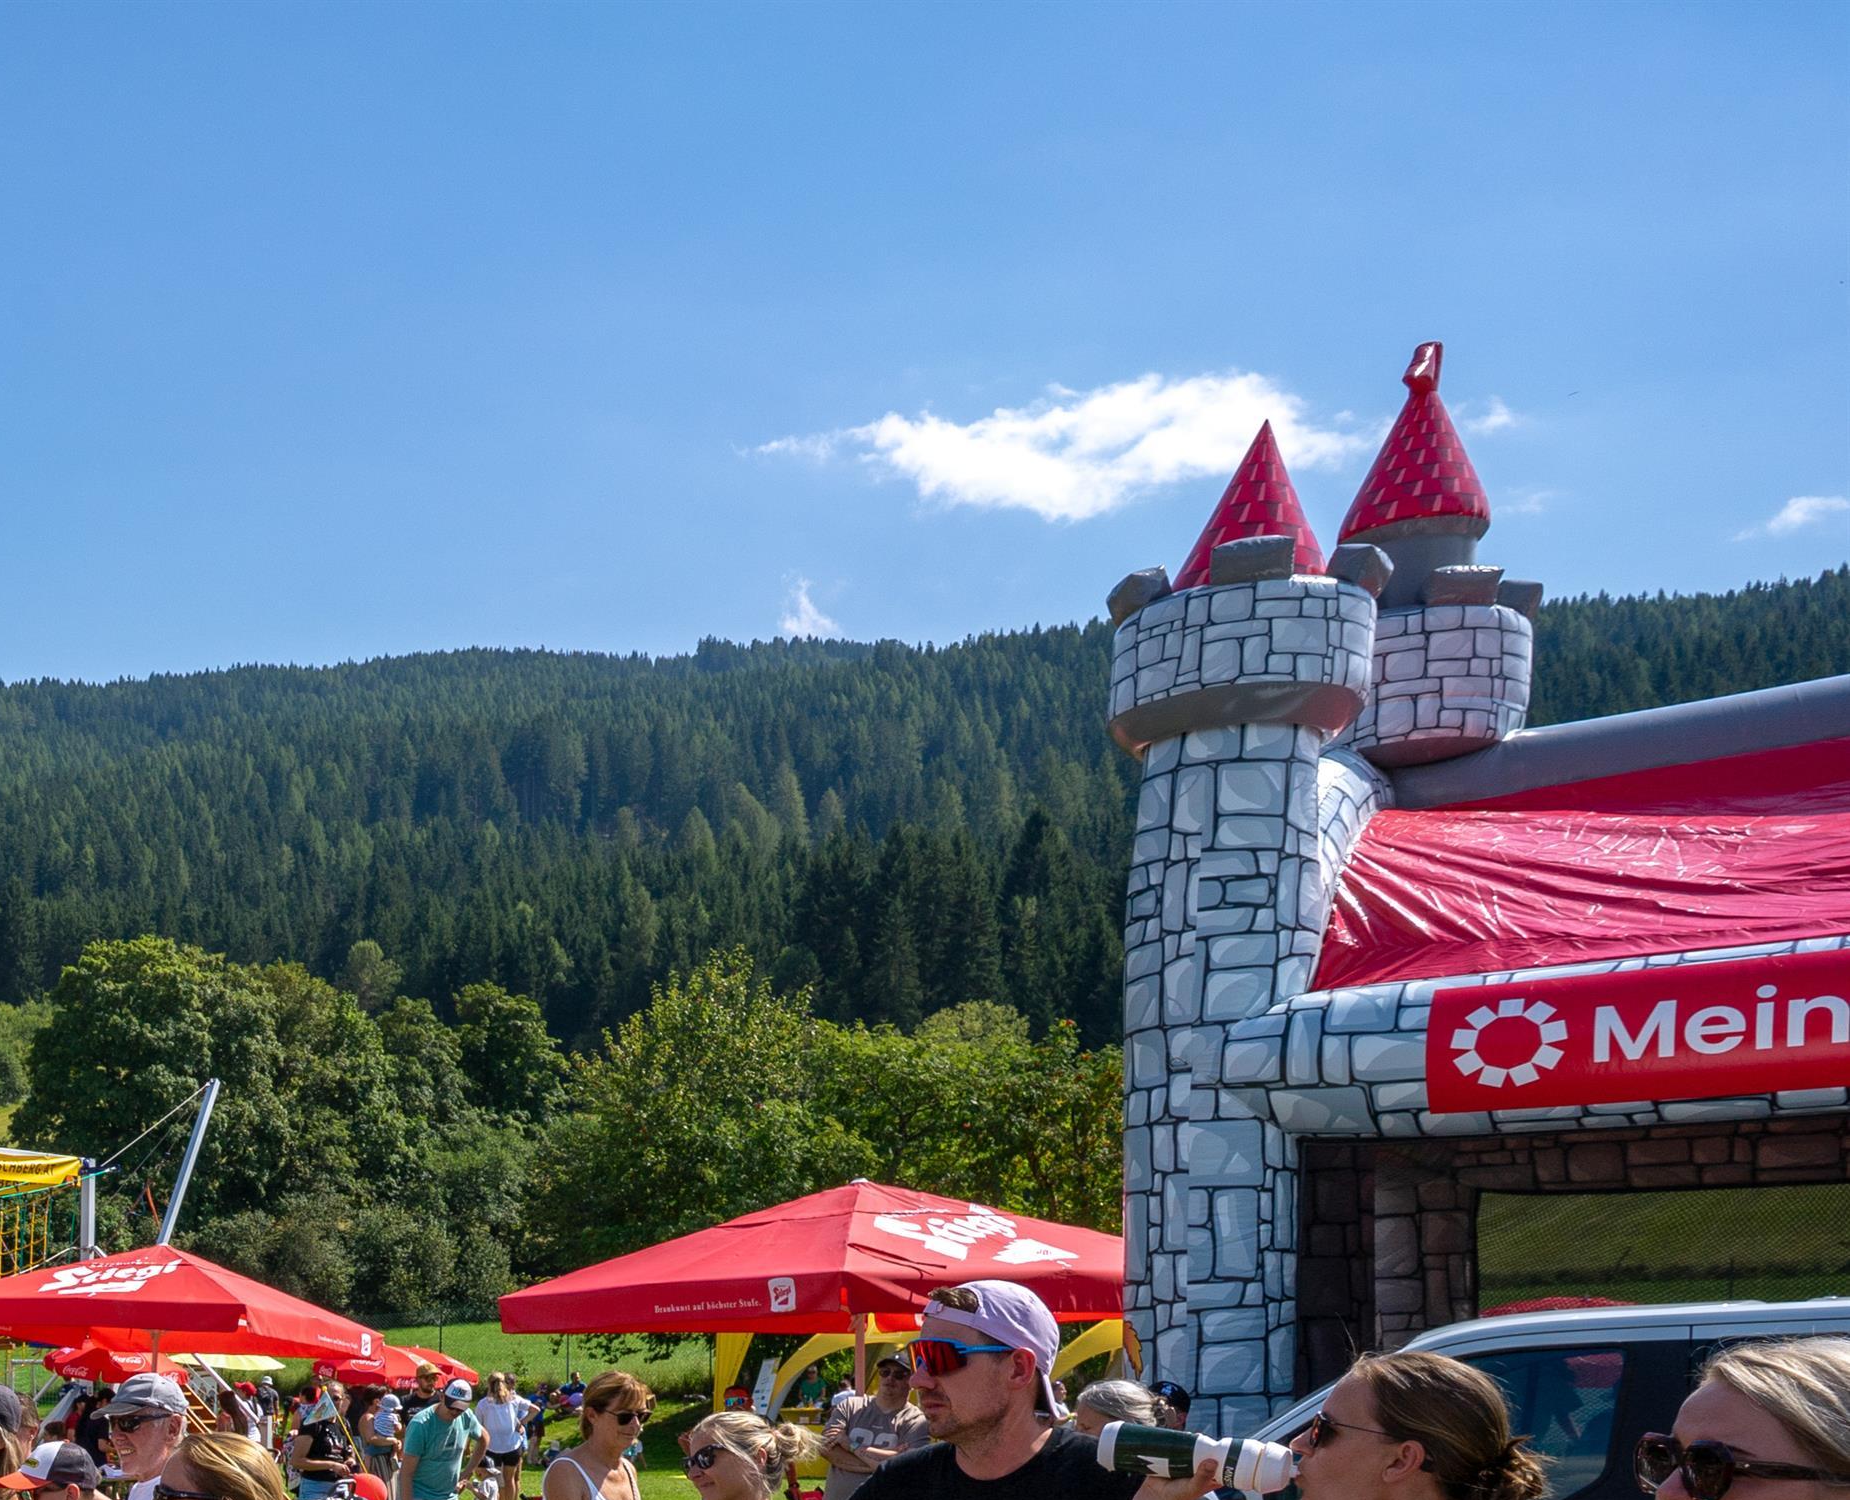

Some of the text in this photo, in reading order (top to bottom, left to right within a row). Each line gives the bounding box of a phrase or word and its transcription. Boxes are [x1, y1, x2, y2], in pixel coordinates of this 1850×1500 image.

[1593, 984, 1850, 1063] Mein
[38, 1258, 183, 1293] Stiegl
[62, 1364, 89, 1378] Coca-Cola
